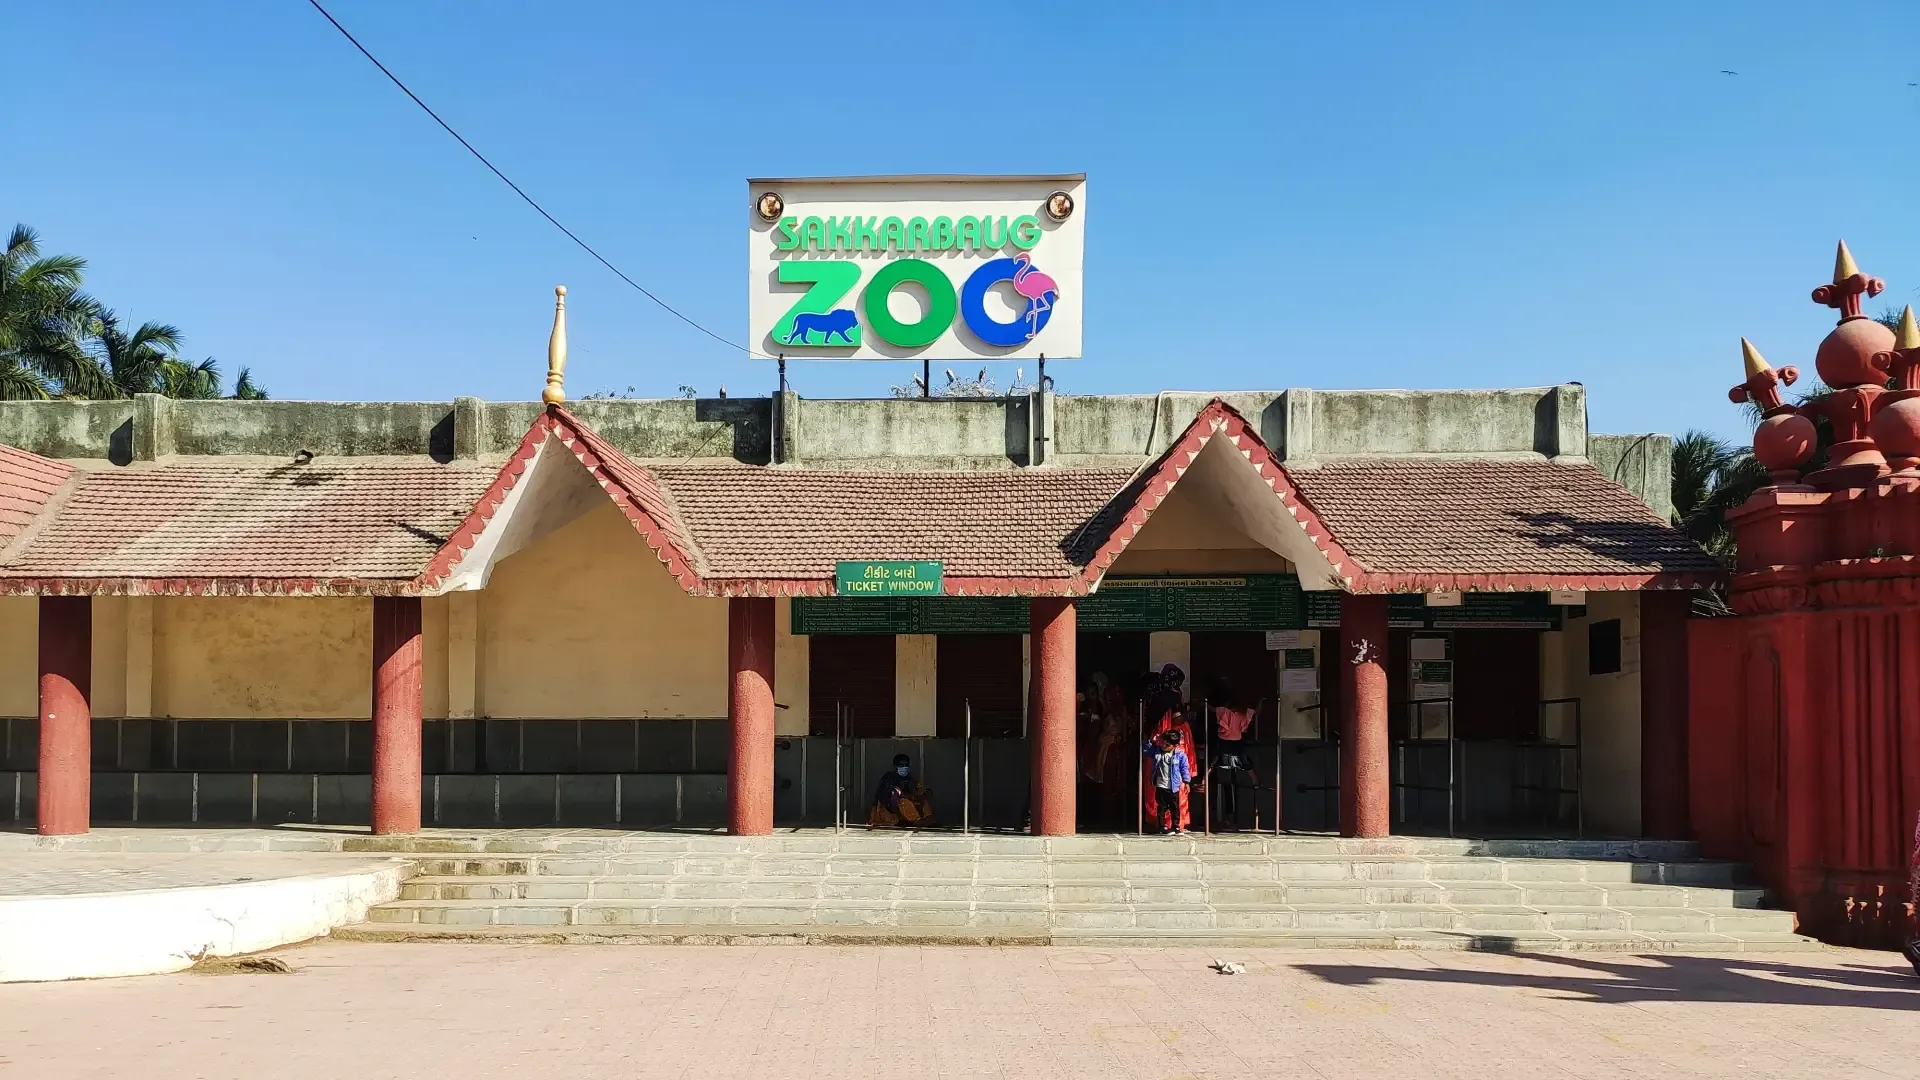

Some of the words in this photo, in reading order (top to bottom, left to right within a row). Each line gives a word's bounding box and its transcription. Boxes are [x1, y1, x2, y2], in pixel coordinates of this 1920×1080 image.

[778, 215, 1043, 250] SAKKARBAUG
[771, 257, 1055, 347] ZOO
[864, 565, 890, 579] ટીકીટ
[894, 565, 916, 579] બારી
[846, 581, 884, 591] TICKET
[888, 581, 934, 591] WINDOW
